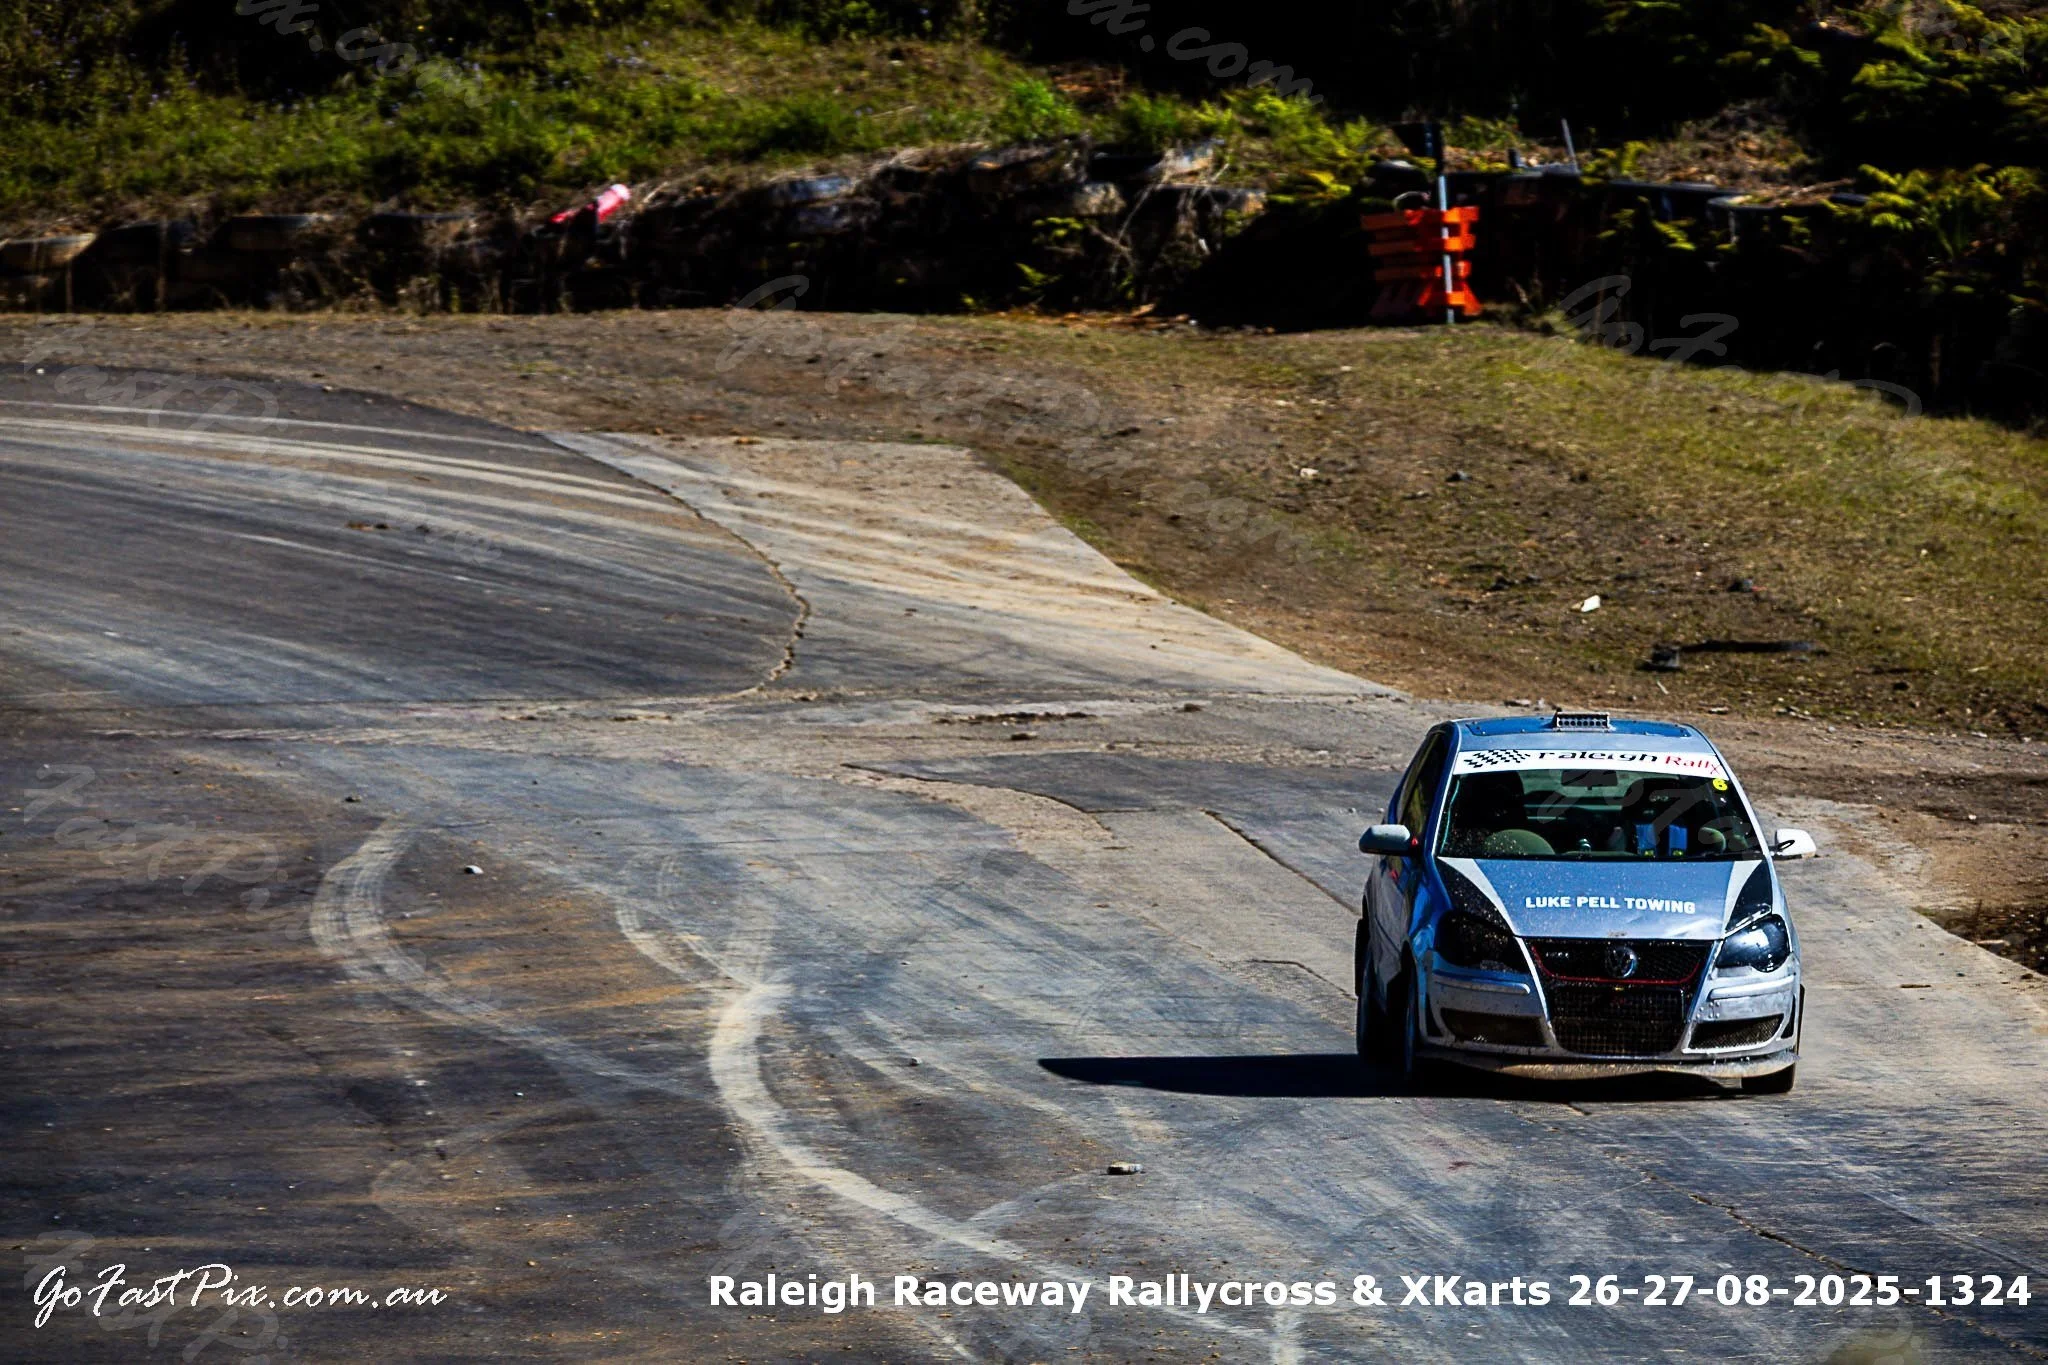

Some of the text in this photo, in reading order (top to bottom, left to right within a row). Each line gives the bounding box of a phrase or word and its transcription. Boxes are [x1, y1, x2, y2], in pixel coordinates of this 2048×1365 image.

[1525, 896, 1697, 915] LUKE PELL TOWING
